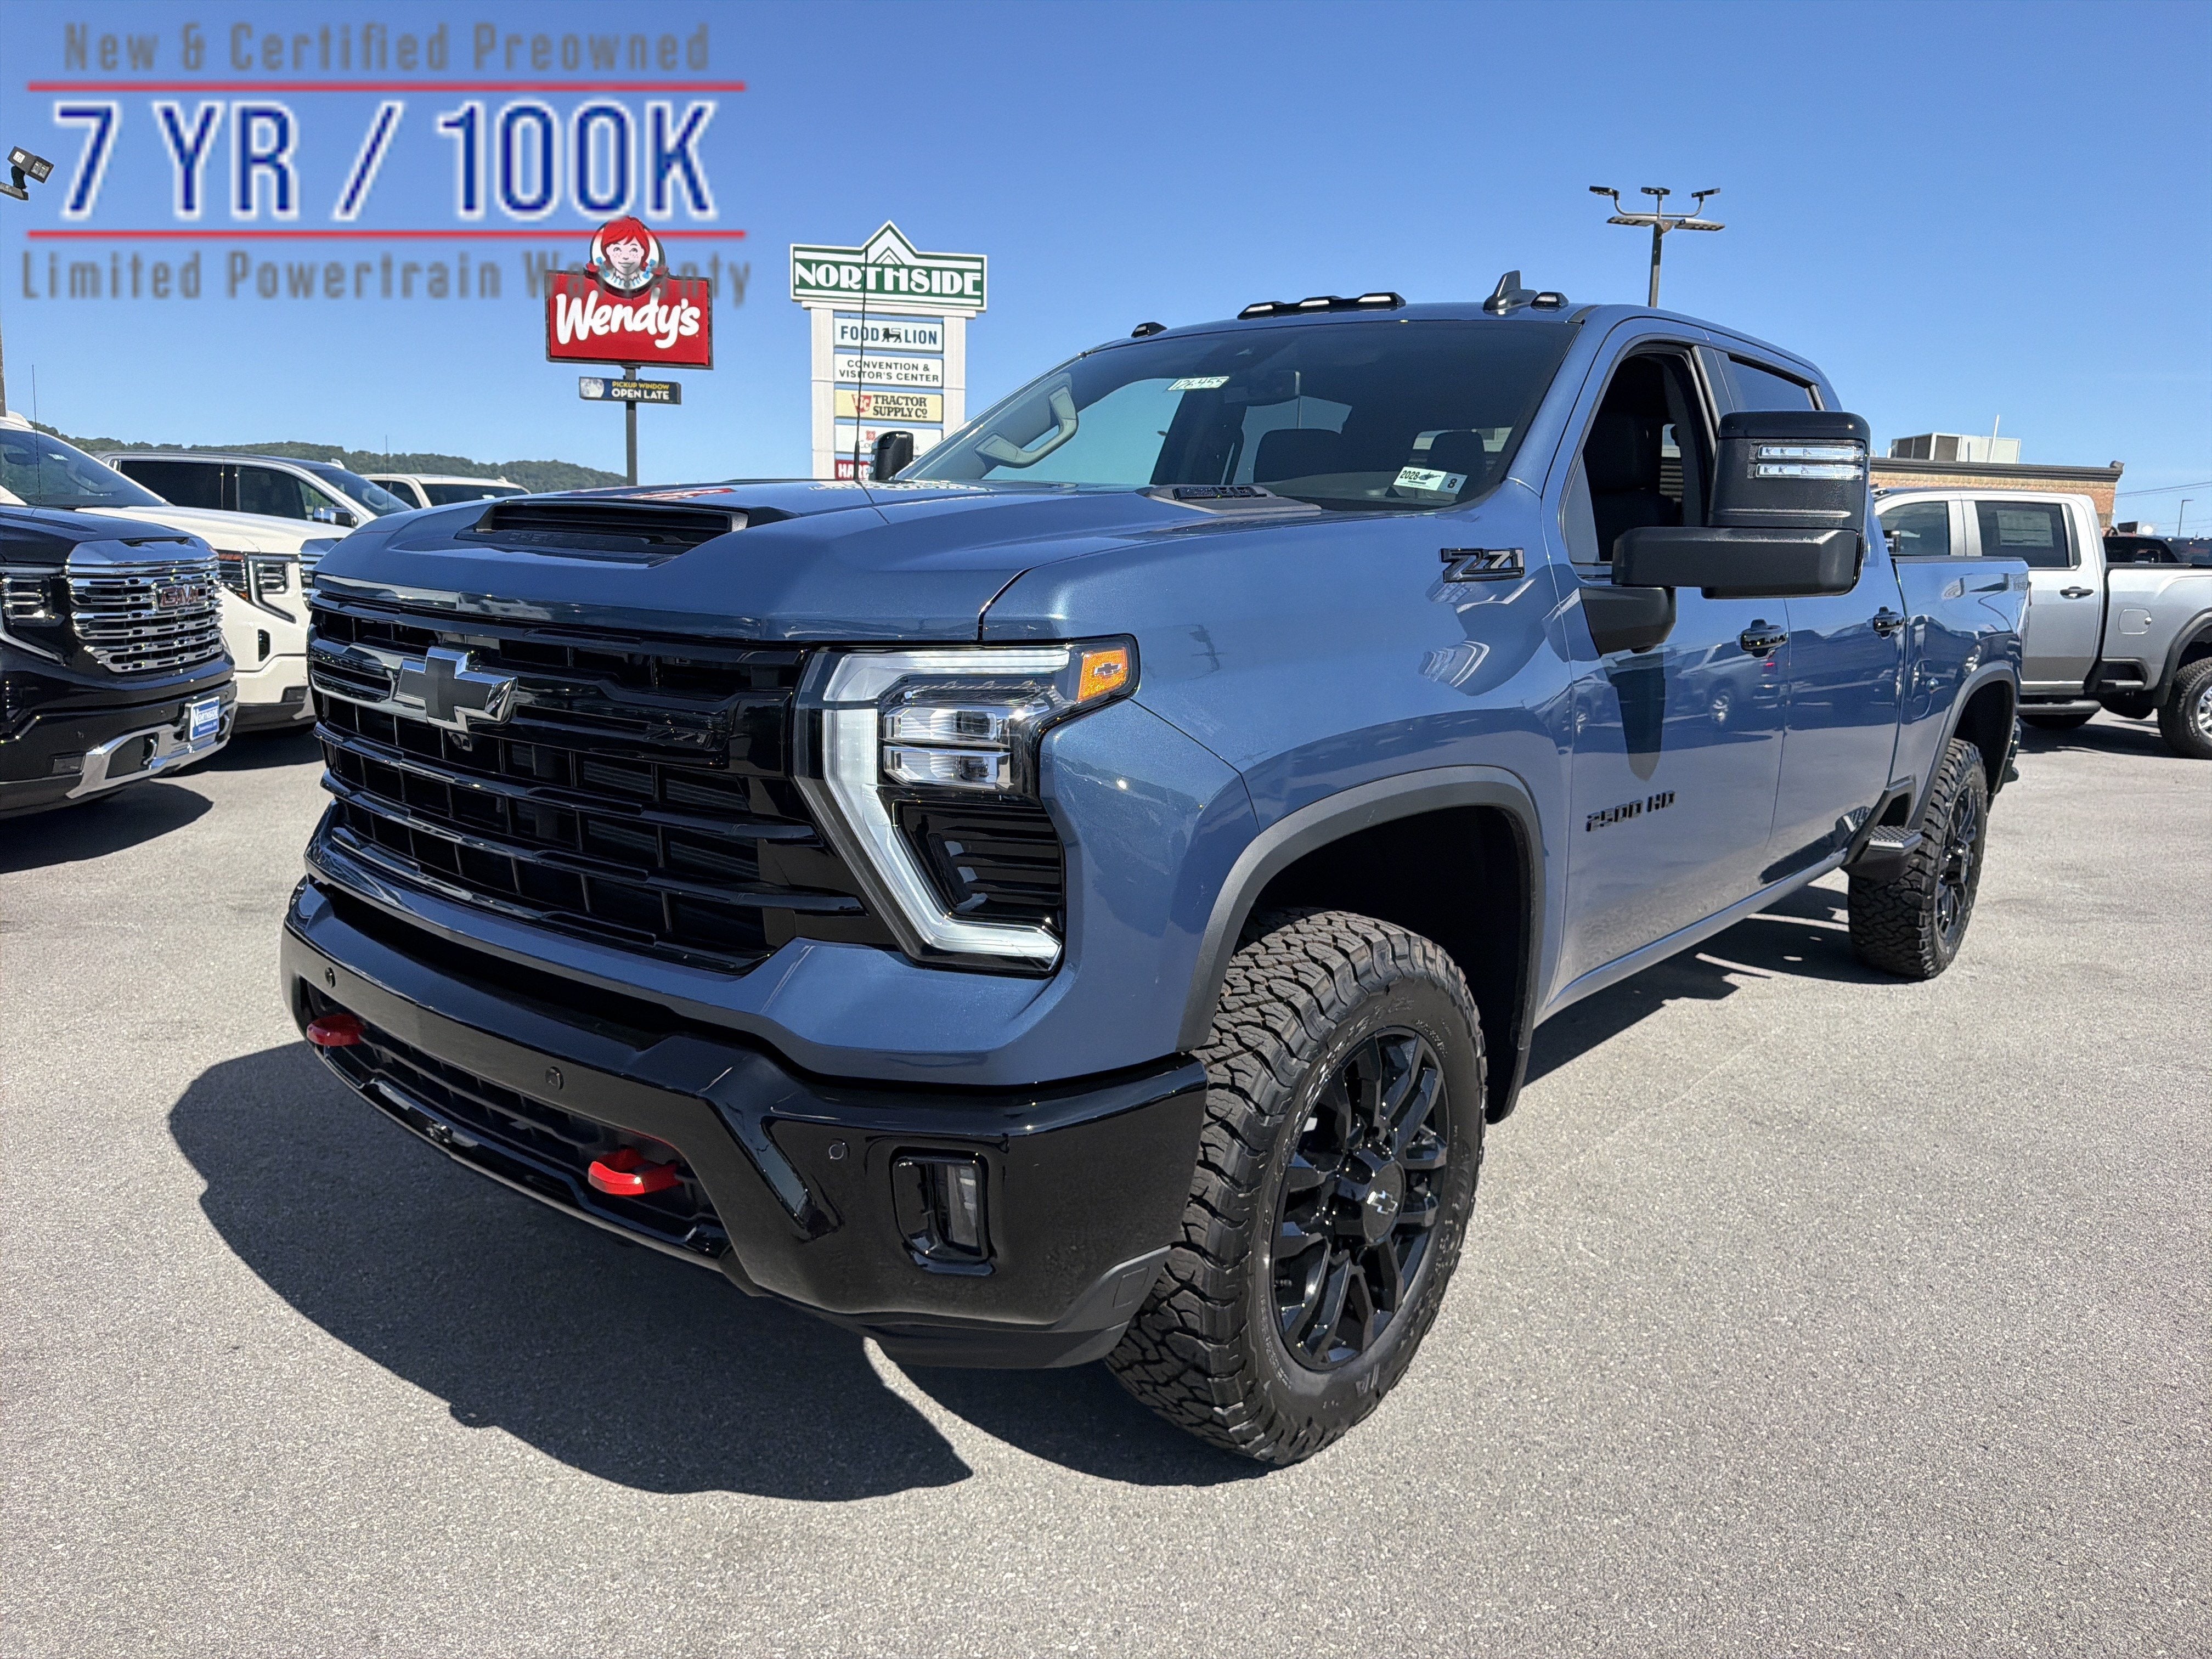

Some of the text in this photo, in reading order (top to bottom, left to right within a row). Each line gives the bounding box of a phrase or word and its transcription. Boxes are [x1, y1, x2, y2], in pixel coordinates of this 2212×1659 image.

[795, 262, 981, 296] NORTHSIDE
[556, 287, 701, 349] Wendy's
[840, 325, 937, 345] FOOD LION
[847, 360, 930, 372] CONVENTION &
[839, 369, 939, 382] VISITOR'S CENTER
[611, 388, 670, 400] OPEN LATE
[873, 394, 928, 407] TRACTOR
[873, 405, 914, 418] SUPPLY
[1400, 470, 1420, 481] 2028
[1447, 478, 1458, 489] 8
[1440, 548, 1525, 583] Z71
[160, 585, 206, 607] GMC
[1585, 790, 1676, 832] 2500 HD
